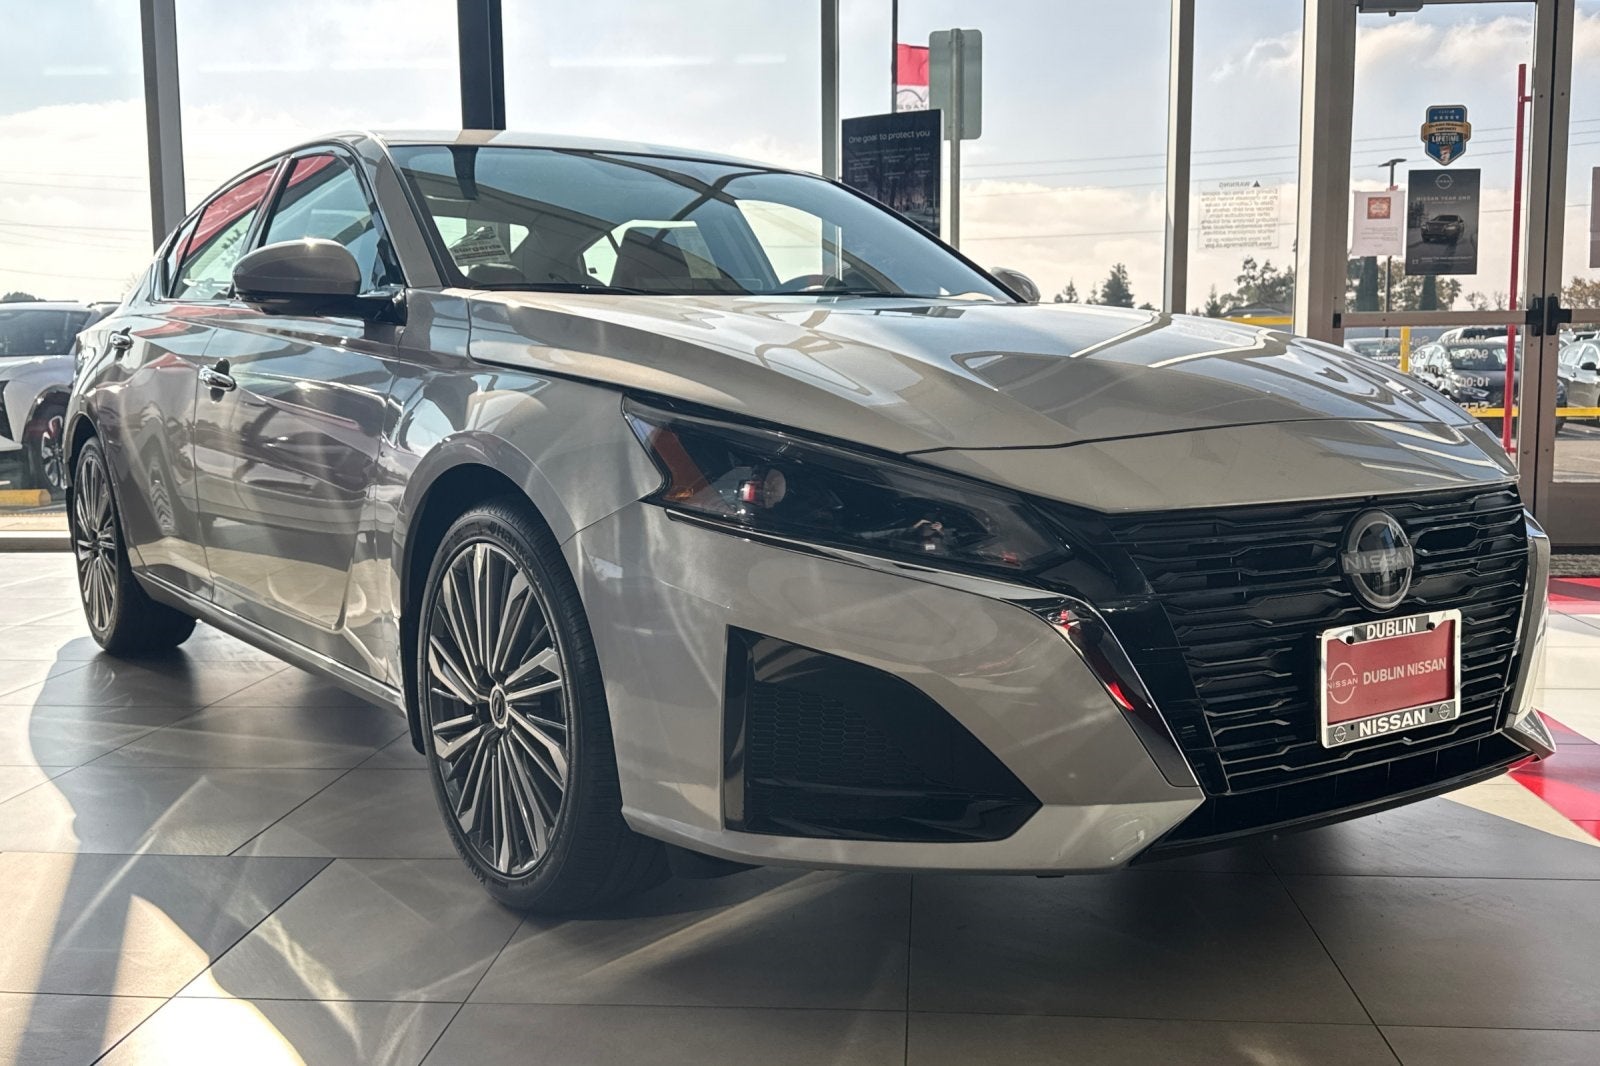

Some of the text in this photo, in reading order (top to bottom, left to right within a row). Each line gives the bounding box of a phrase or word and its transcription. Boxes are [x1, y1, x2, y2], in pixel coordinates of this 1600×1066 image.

[849, 136, 861, 144] One
[888, 131, 914, 141] protect
[916, 130, 930, 138] you
[1344, 550, 1413, 570] NISSAN
[1366, 618, 1417, 640] DUBLIN
[1363, 657, 1447, 685] DUBLIN NISSAN
[1327, 677, 1358, 690] NISSAN
[1359, 709, 1426, 737] NISSAN
